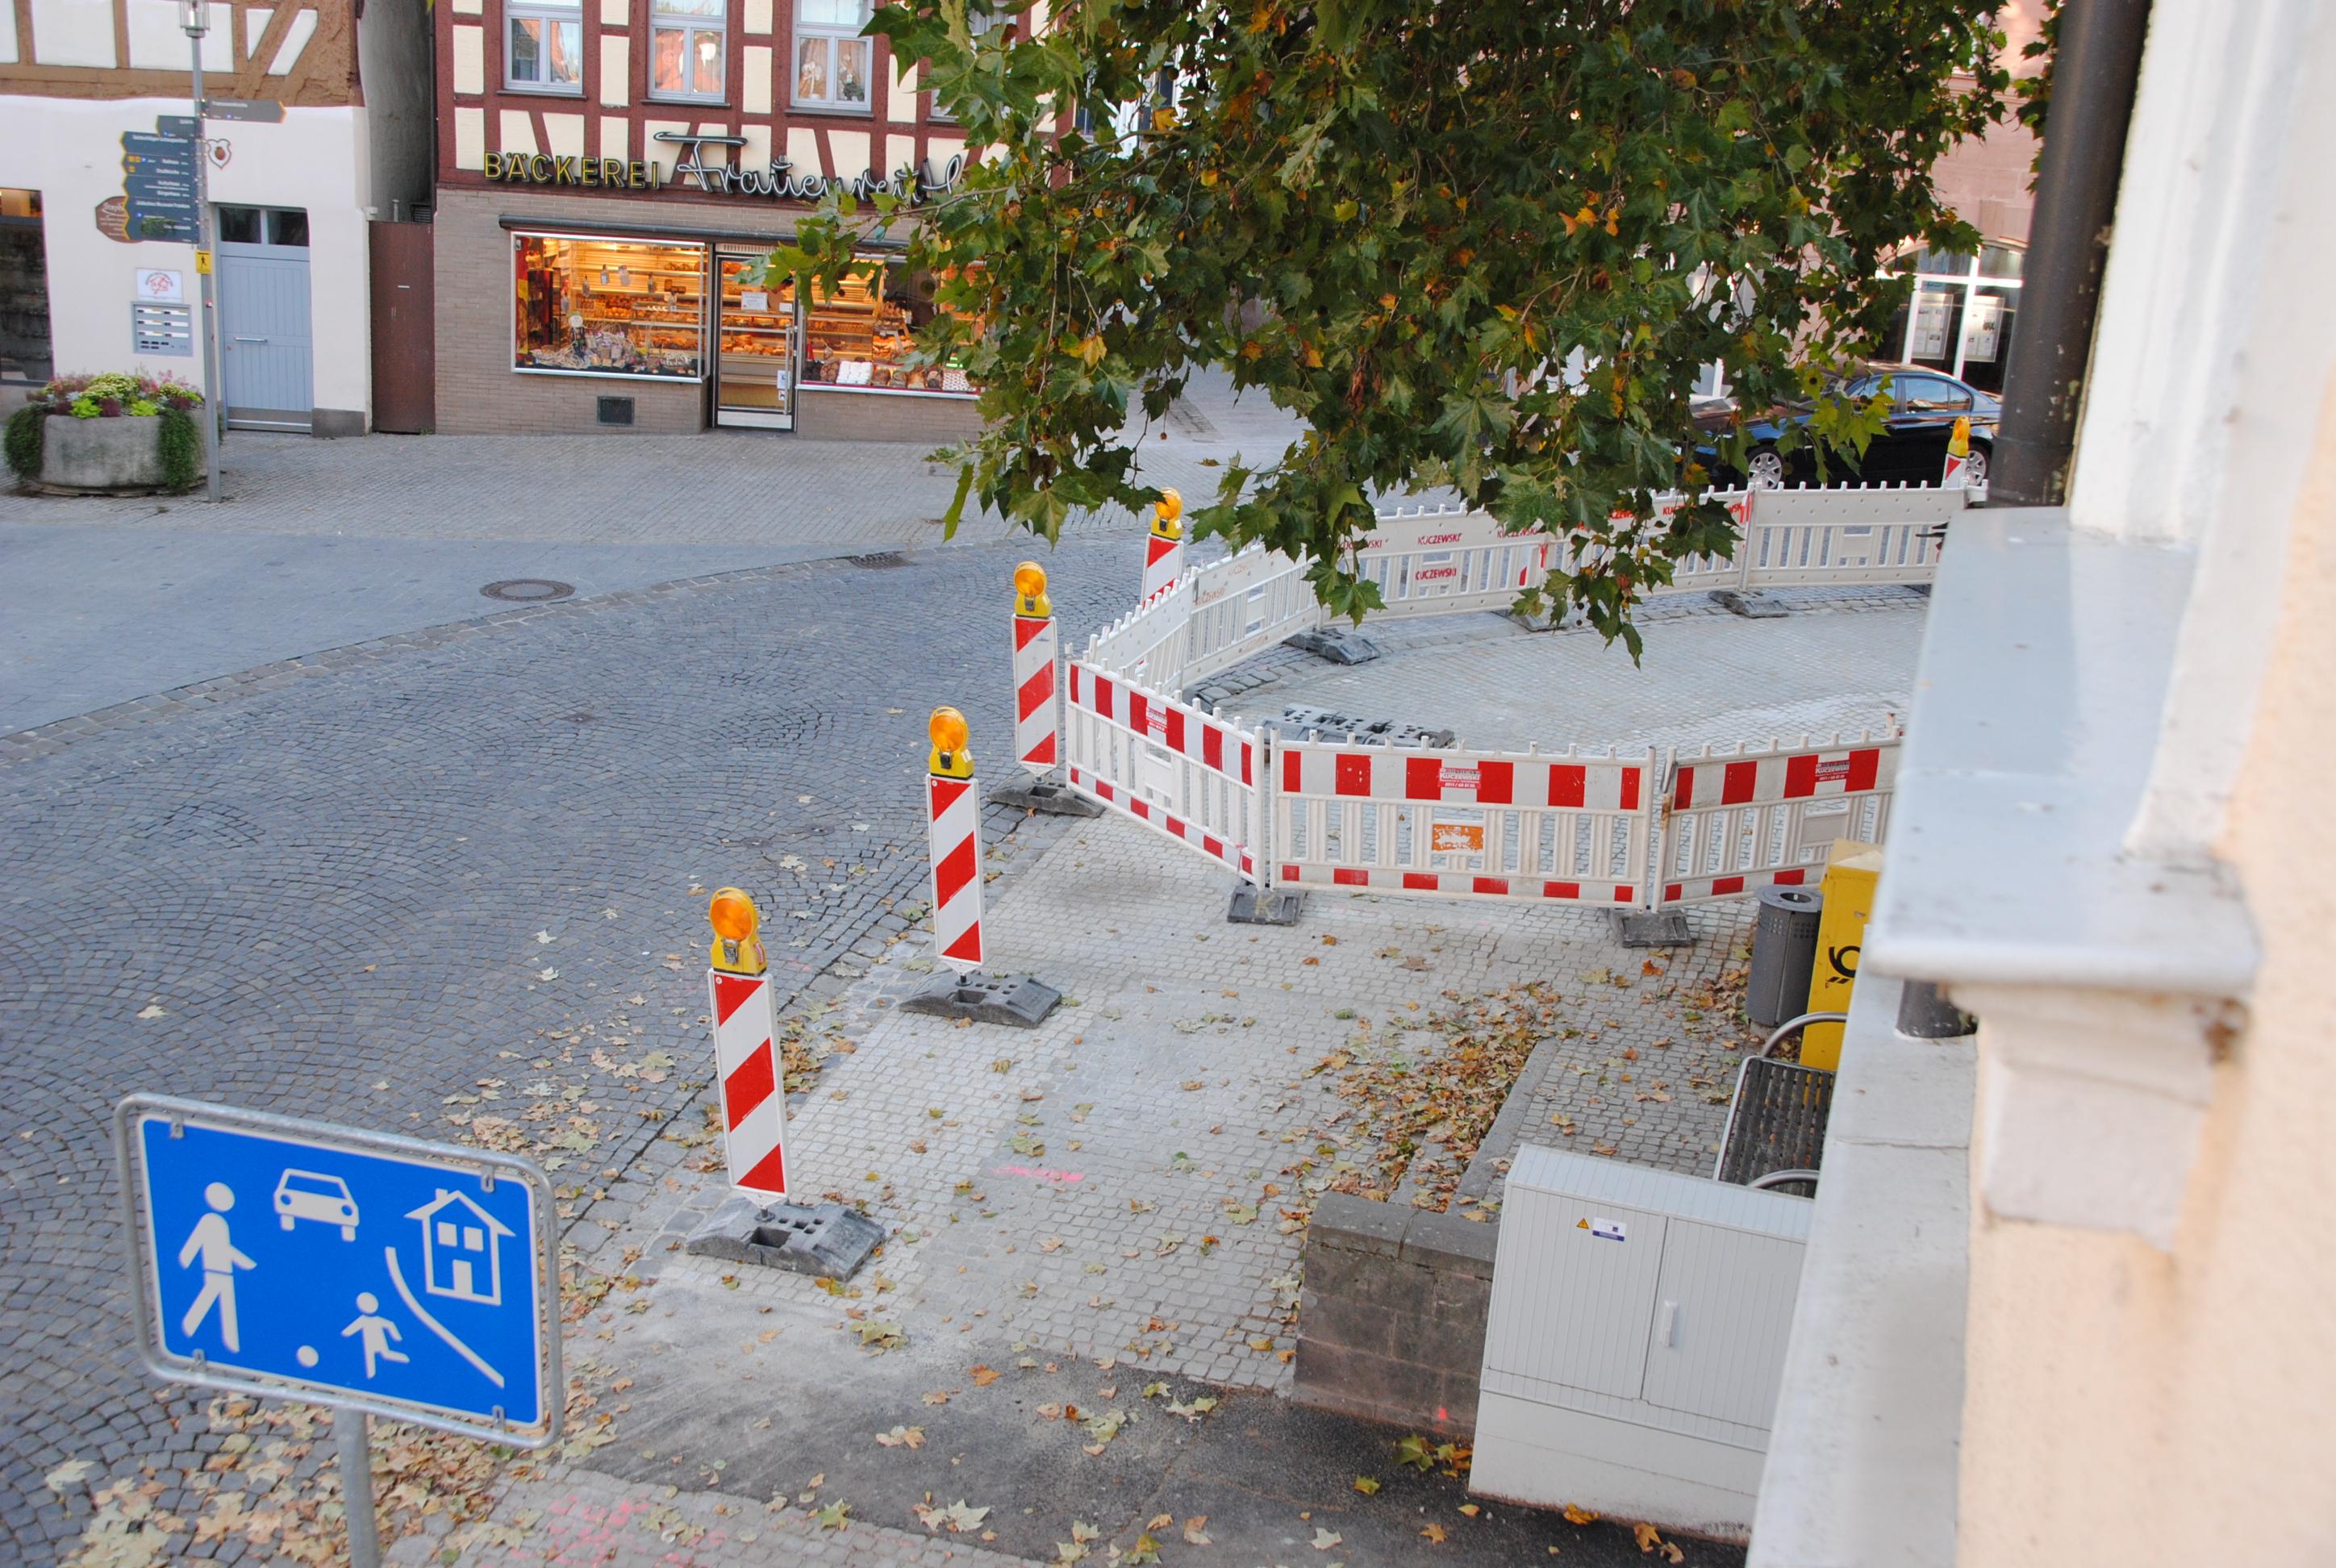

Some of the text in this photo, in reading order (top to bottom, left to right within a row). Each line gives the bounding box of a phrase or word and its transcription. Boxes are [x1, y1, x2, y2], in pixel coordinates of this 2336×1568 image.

[485, 152, 660, 190] BÄCKEREI
[1417, 533, 1461, 545] KUCZEWSKI
[1415, 567, 1457, 581] KUCZEWSKI
